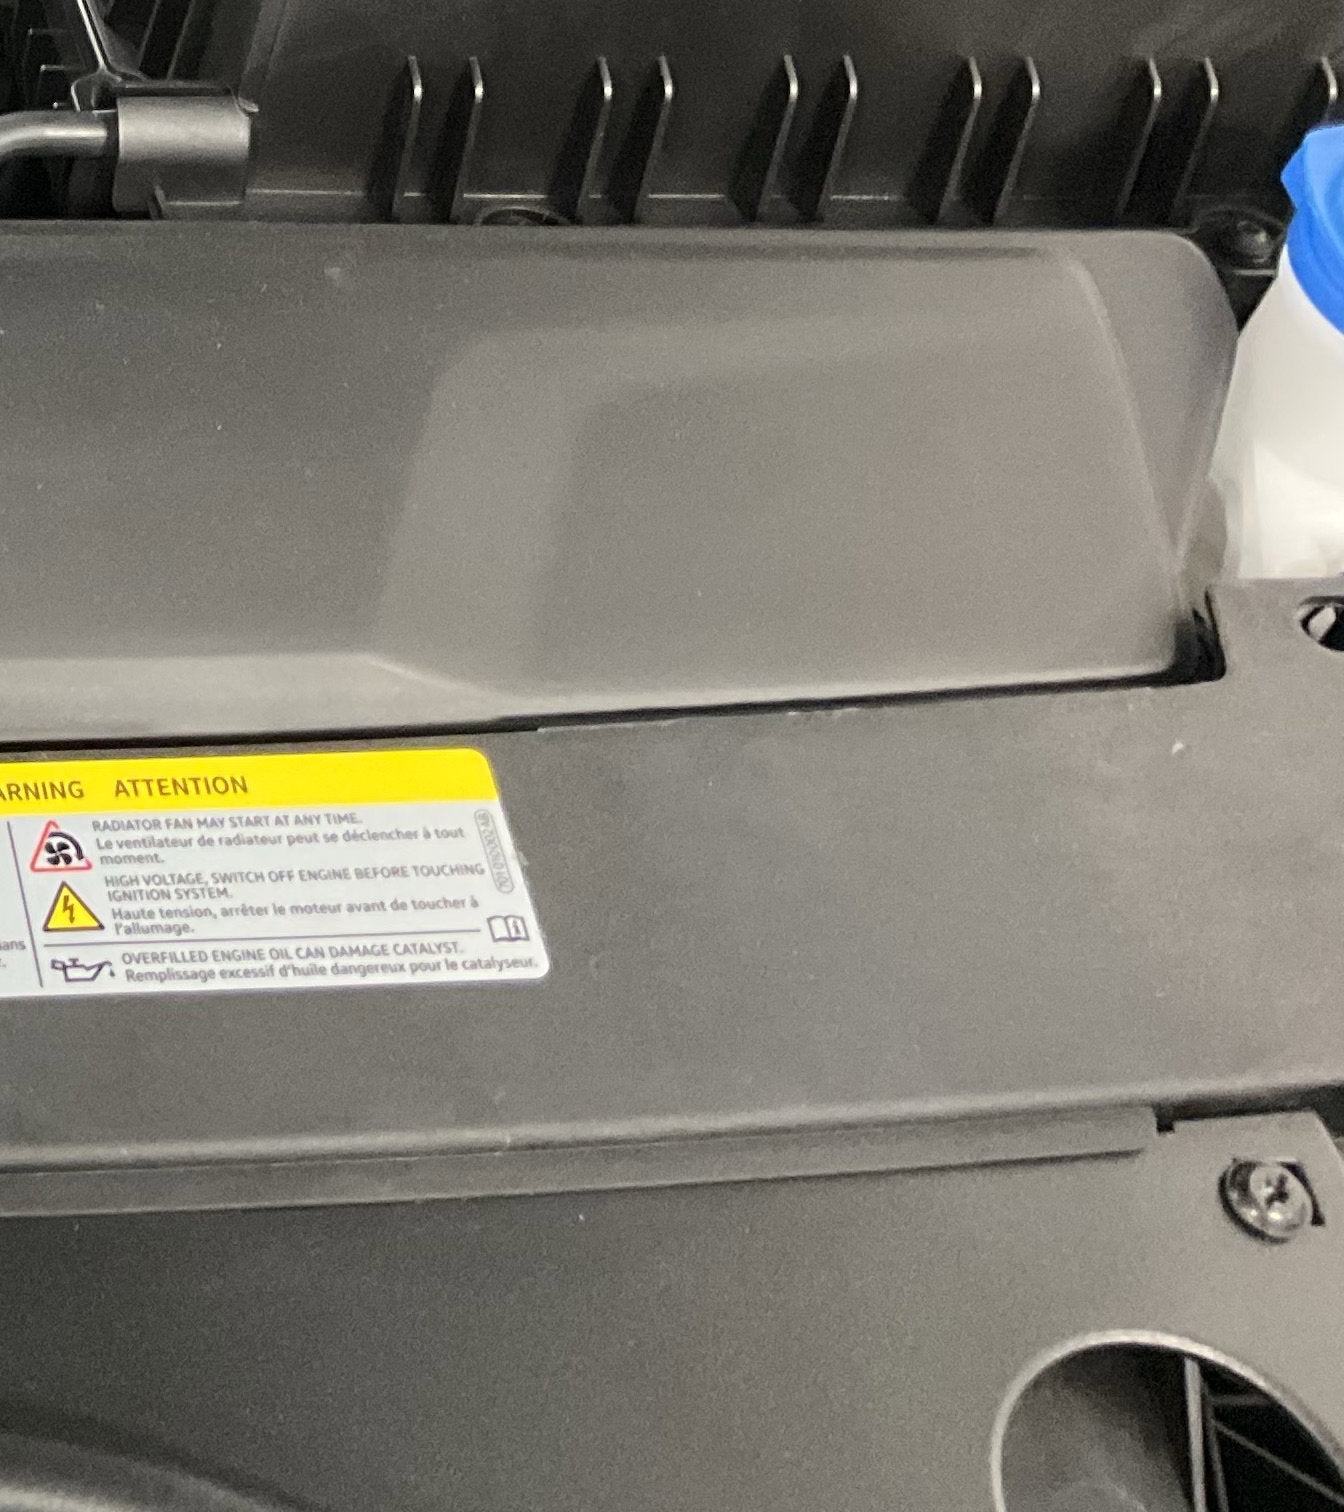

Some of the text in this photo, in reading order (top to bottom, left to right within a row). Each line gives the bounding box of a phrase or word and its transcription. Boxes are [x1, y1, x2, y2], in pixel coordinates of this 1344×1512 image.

[114, 775, 249, 798] ATTENTION
[91, 812, 363, 833] RADIATOR FAN MAY START AT ANY TIME.
[104, 863, 486, 888] HIGH VOLTAGE, SWITCH OFF ENGINE BEFORE TOUCHING
[107, 887, 233, 903] IGNITION SYSTEM.
[111, 895, 480, 921] Haute tension, arrêter le moteur avant de toucher à
[121, 941, 463, 965] OVERFILLED ENGINE OIL CAN DAMAGE CATALYST.
